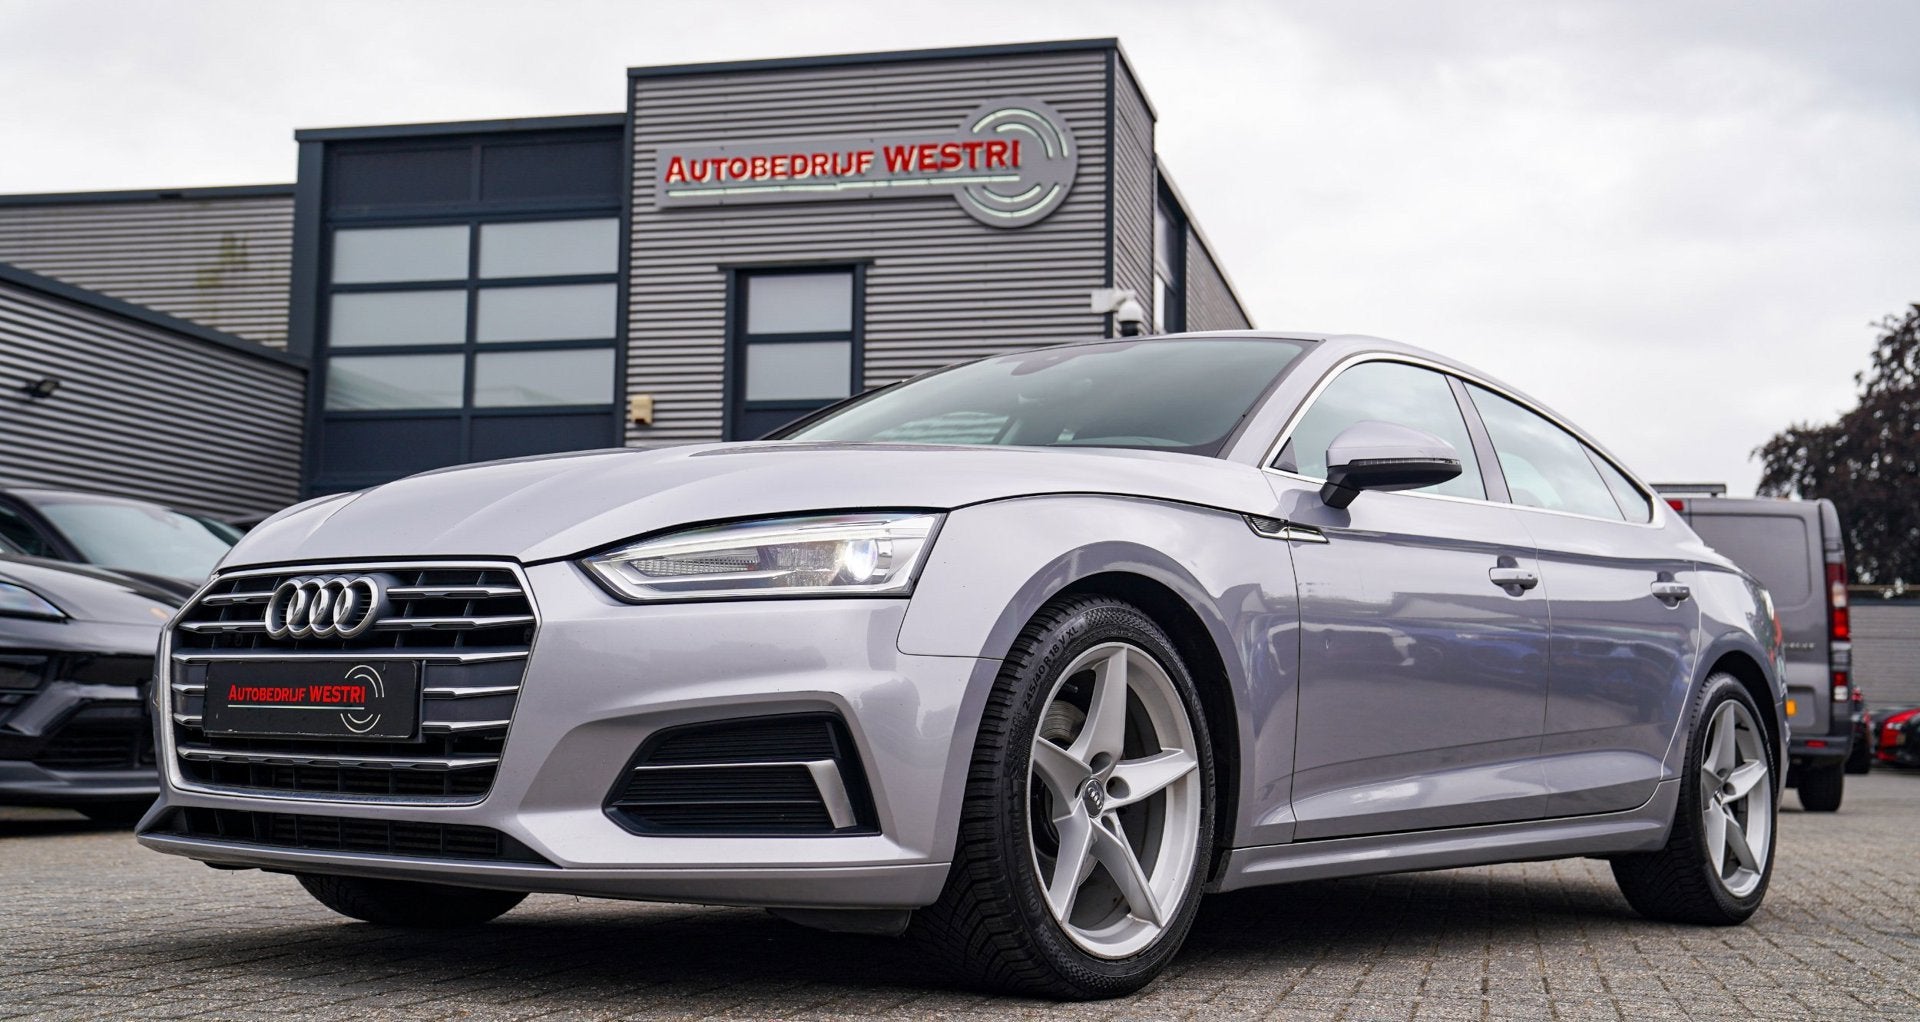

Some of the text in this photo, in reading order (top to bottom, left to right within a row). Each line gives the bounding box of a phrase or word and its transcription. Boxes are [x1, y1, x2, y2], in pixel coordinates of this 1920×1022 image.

[664, 140, 1021, 184] AUTOBEDRIJF WESTRI
[1022, 665, 1046, 711] 245/40
[1065, 627, 1079, 638] XL
[228, 684, 366, 703] AUTOBEDRIJF WESTRI
